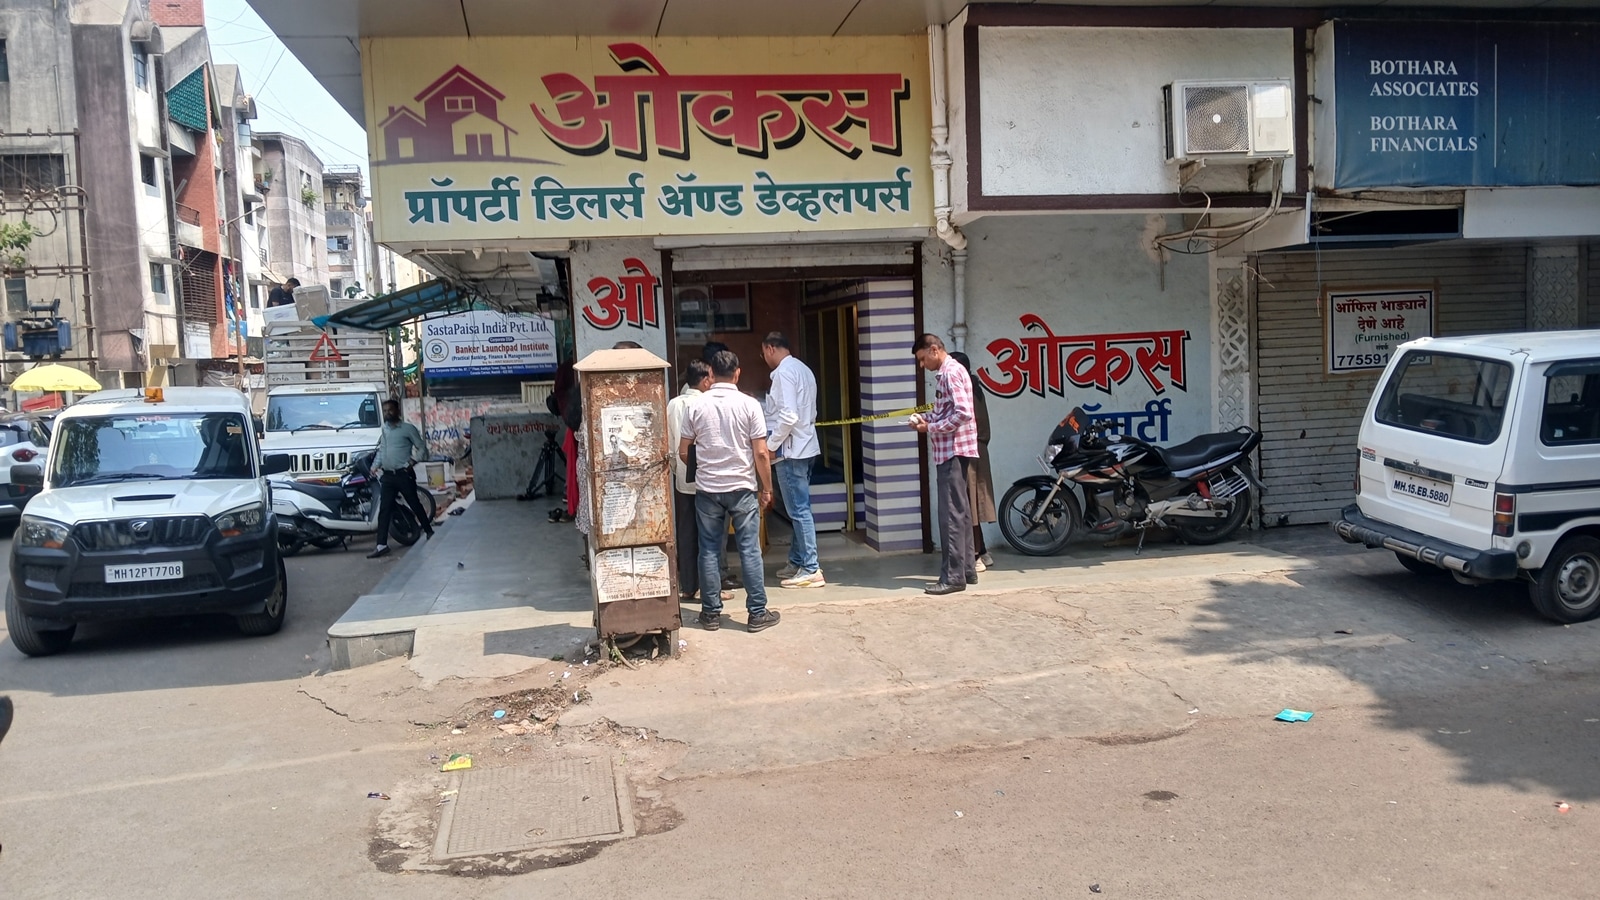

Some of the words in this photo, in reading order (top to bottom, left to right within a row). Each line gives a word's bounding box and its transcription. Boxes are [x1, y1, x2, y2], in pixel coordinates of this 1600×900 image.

[1370, 60, 1458, 76] BOTHARA
[1370, 81, 1479, 97] ASSOCIATES
[530, 43, 910, 161] ओकस
[1370, 116, 1458, 131] BOTHARA
[1370, 137, 1478, 152] FINANCIALS
[405, 176, 520, 224] प्रॉपर्टी
[532, 172, 645, 221] डिलर्स
[754, 167, 911, 221] डेव्हलपर्स
[583, 258, 661, 330] ओ
[1335, 299, 1377, 313] ऑफिस
[1381, 296, 1427, 311] भाड्याने
[427, 323, 480, 336] SastaPaisa
[482, 322, 507, 334] India
[510, 323, 529, 333] Pvt.
[531, 321, 549, 332] Ltd.
[1357, 316, 1377, 332] देणे
[1381, 315, 1405, 331] आहे
[1355, 332, 1410, 344] (Furnished)
[455, 345, 479, 354] Banker
[482, 344, 518, 354] Launchpad
[520, 343, 549, 351] Institute
[977, 313, 1192, 399] ओकस
[1393, 481, 1449, 504] MH.15.EB.5880
[114, 564, 182, 579] MH12PT7708
